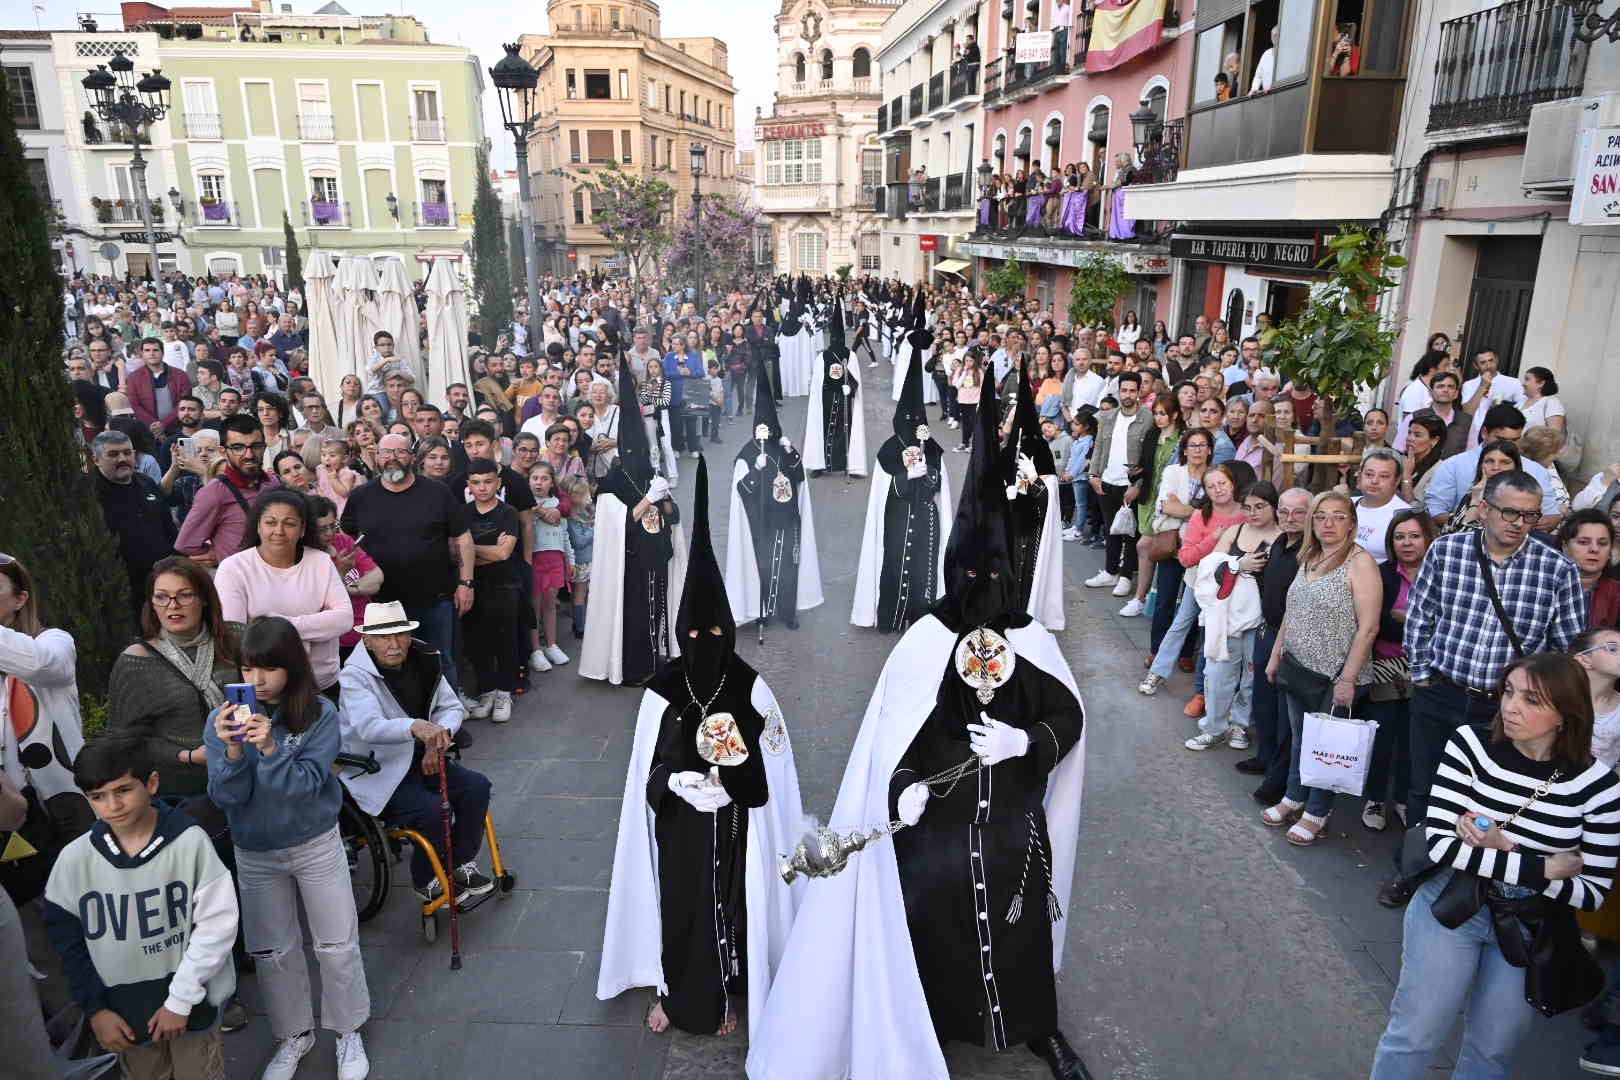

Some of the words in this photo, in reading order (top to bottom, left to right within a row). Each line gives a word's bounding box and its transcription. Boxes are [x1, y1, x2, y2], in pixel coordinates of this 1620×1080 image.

[763, 123, 825, 140] CERVANTES
[1591, 174, 1617, 194] SAN
[1191, 240, 1205, 254] BAR
[1250, 243, 1267, 261] AJO
[1274, 245, 1309, 262] NEGRO
[78, 880, 188, 941] OVER
[143, 941, 163, 956] THE
